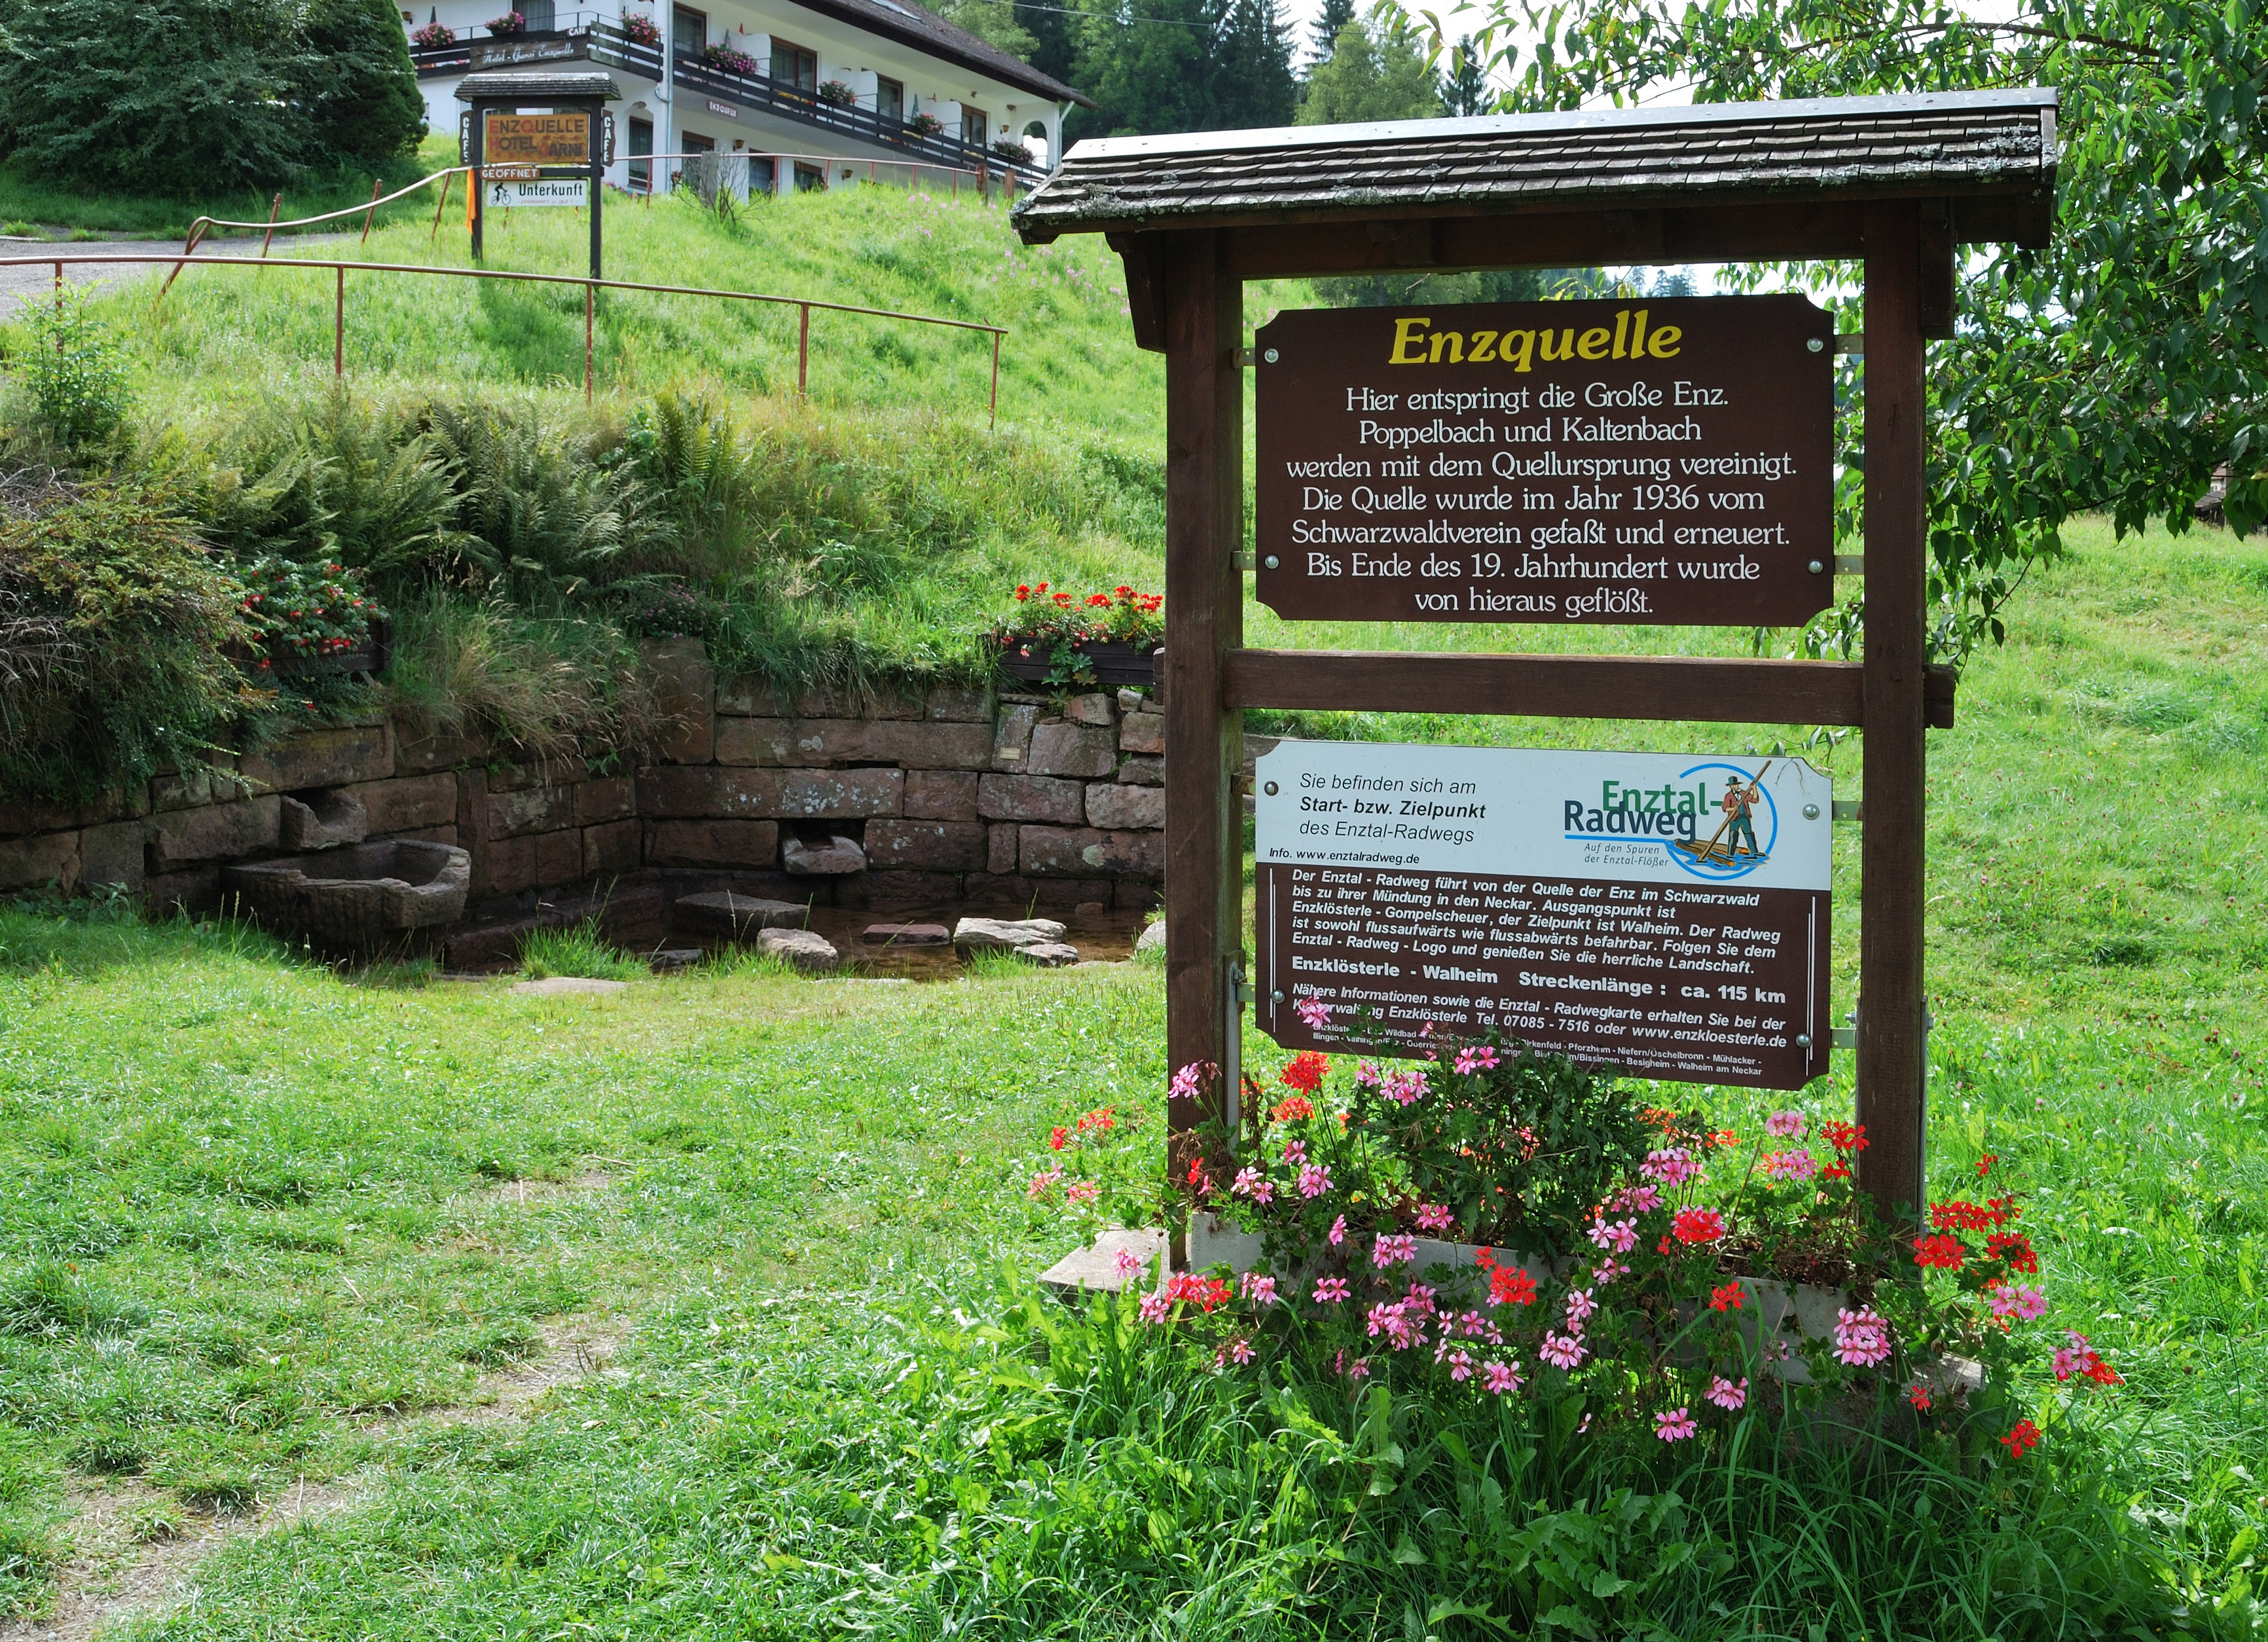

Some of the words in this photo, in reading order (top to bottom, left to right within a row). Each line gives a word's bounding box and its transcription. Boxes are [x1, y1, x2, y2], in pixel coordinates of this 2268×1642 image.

[488, 136, 537, 151] HOTEL
[538, 142, 583, 156] GARNI
[481, 168, 538, 178] GEÖFFNET
[519, 182, 583, 196] Unterkunft
[1388, 309, 1682, 373] Enzquelle
[1346, 387, 1399, 411] Hier
[1407, 386, 1530, 415] entspringt
[1539, 382, 1575, 409] die
[1584, 381, 1663, 407] Große
[1674, 380, 1728, 406] Enz.
[1359, 418, 1495, 450] Poppelbach
[1504, 416, 1552, 443] und
[1562, 414, 1702, 442] Kaltenbach
[1286, 453, 1372, 478] werden
[1381, 454, 1421, 477] mit
[1429, 452, 1483, 477] dem
[1491, 450, 1671, 481] Quellursprung
[1679, 452, 1797, 481] vereinigt.
[1303, 486, 1343, 511] Die
[1351, 485, 1427, 514] Quelle
[1435, 484, 1513, 510] wurde
[1522, 487, 1556, 510] im
[1564, 484, 1622, 510] Jahr
[1632, 484, 1700, 511] 1936
[1708, 492, 1765, 510] vom
[1292, 519, 1522, 544] Schwarzwaldverein
[1530, 518, 1607, 550] gefaßt
[1615, 519, 1665, 545] und
[1674, 522, 1790, 545] erneuert.
[1307, 552, 1342, 577] Bis
[1351, 552, 1412, 577] Ende
[1420, 552, 1461, 577] des
[1471, 553, 1505, 578] 19.
[1514, 553, 1669, 579] Jahrhundert
[1677, 554, 1761, 580] wurde
[1414, 594, 1459, 611] von
[1469, 586, 1556, 612] hieraus
[1565, 587, 1653, 618] geflößt.
[1300, 773, 1326, 789] Sie
[1331, 774, 1404, 792] befinden
[1410, 777, 1443, 793] sich
[1449, 782, 1476, 794] am
[1300, 796, 1348, 812] Start-
[1353, 798, 1393, 814] bzw.
[1399, 800, 1486, 820] Zielpunkt
[1564, 799, 1698, 845] Radweg
[1300, 820, 1329, 835] des
[1334, 821, 1474, 845] Enztal-Radwegs
[1269, 847, 1292, 858] Info.
[1296, 850, 1419, 866] www.enztalradweg.de
[1584, 843, 1602, 854] Auf
[1605, 843, 1622, 852] den
[1626, 844, 1660, 855] Spuren
[1584, 854, 1600, 863] der
[1603, 854, 1669, 868] Enztal-Flößer
[1292, 868, 1317, 881] Der
[1321, 870, 1363, 885] Enztal
[1376, 873, 1430, 891] Radweg
[1435, 876, 1468, 890] führt
[1472, 881, 1497, 892] von
[1503, 881, 1527, 894] der
[1532, 882, 1574, 896] Quelle
[1579, 885, 1603, 898] der
[1609, 886, 1636, 900] Enz
[1641, 887, 1658, 901] im
[1664, 888, 1760, 906] Schwarzwald
[1292, 885, 1312, 898] bis
[1317, 888, 1332, 899] zu
[1337, 886, 1368, 900] ihrer
[1372, 889, 1432, 907] Mündung
[1436, 892, 1449, 905] in
[1454, 894, 1479, 907] den
[1484, 896, 1537, 911] Neckar.
[1541, 899, 1652, 918] Ausgangspunkt
[1656, 905, 1676, 919] ist
[1292, 900, 1372, 917] Enzklösterle
[1385, 905, 1493, 926] Gompelscheuer,
[1498, 913, 1522, 926] der
[1527, 914, 1592, 931] Zielpunkt
[1596, 918, 1615, 932] ist
[1620, 920, 1683, 936] Walheim.
[1689, 924, 1716, 938] Der
[1721, 926, 1781, 945] Radweg
[1292, 915, 1309, 929] ist
[1314, 919, 1361, 932] sowohl
[1365, 921, 1457, 938] flussaufwärts
[1461, 927, 1485, 940] wie
[1490, 928, 1579, 946] flussabwärts
[1584, 934, 1657, 951] befahrbar.
[1662, 939, 1711, 956] Folgen
[1716, 942, 1739, 956] Sie
[1744, 944, 1776, 958] dem
[1292, 932, 1333, 946] Enztal
[1345, 935, 1399, 953] Radweg
[1412, 940, 1447, 956] Logo
[1452, 943, 1478, 956] und
[1482, 945, 1545, 960] genießen
[1549, 948, 1571, 962] Sie
[1576, 951, 1597, 964] die
[1601, 952, 1664, 968] herrliche
[1668, 956, 1755, 974] Landschaft.
[1292, 955, 1400, 977] Enzklösterle
[1422, 964, 1498, 983] Walheim
[1518, 971, 1653, 997] Streckenlänge
[1681, 986, 1710, 998] ca.
[1717, 985, 1747, 1001] 115
[1755, 987, 1786, 1004] km
[1292, 983, 1336, 1000] Nähere
[1340, 986, 1428, 1004] Informationen
[1432, 994, 1471, 1008] sowie
[1474, 996, 1494, 1009] die
[1499, 998, 1541, 1013] Enztal
[1554, 1002, 1643, 1021] Radwegkarte
[1647, 1009, 1703, 1025] erhalten
[1708, 1013, 1729, 1027] Sie
[1734, 1015, 1757, 1029] bei
[1762, 1017, 1786, 1031] der
[1385, 1028, 1417, 1038] Wildbad
[1389, 1006, 1467, 1023] Enzklösterle
[1476, 1012, 1499, 1026] Tel.
[1503, 1014, 1545, 1029] 07085
[1558, 1018, 1590, 1032] 7516
[1594, 1022, 1627, 1035] oder
[1632, 1027, 1787, 1048] www.enzkloesterle.de
